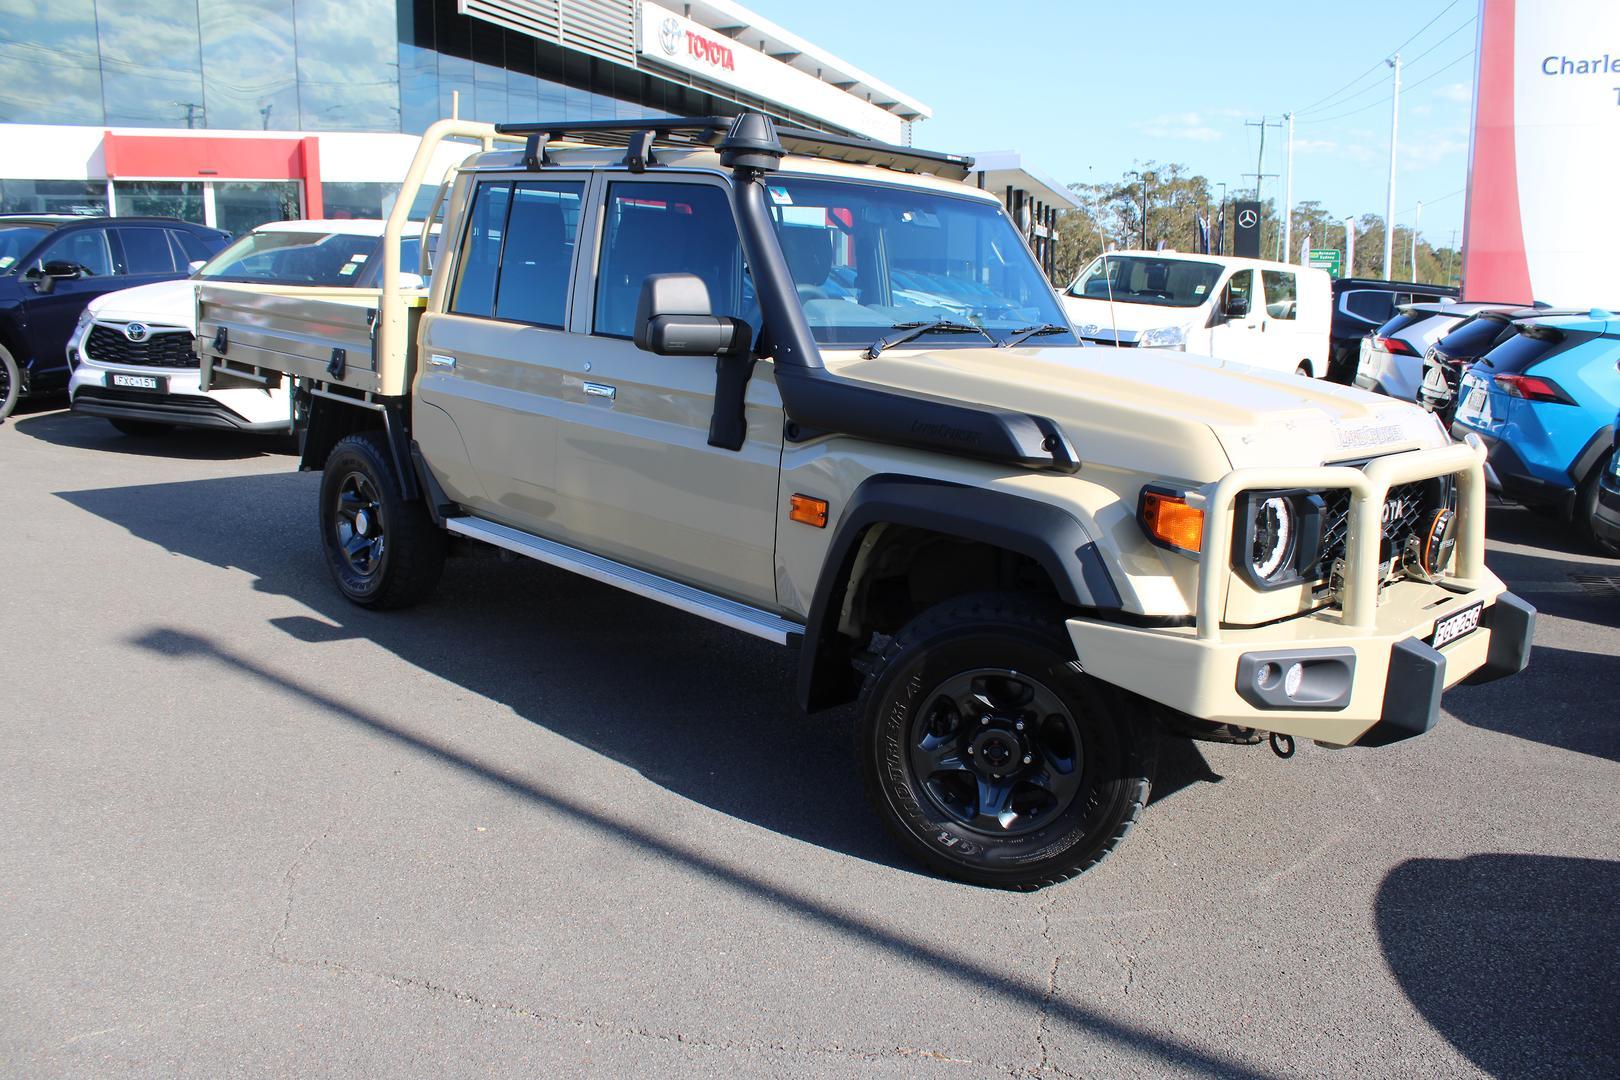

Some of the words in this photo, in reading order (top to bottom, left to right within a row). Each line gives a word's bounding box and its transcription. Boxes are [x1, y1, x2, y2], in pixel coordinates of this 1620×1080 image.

[685, 29, 735, 71] TOYOTA
[1541, 54, 1620, 76] Charle
[1381, 500, 1403, 523] OTA
